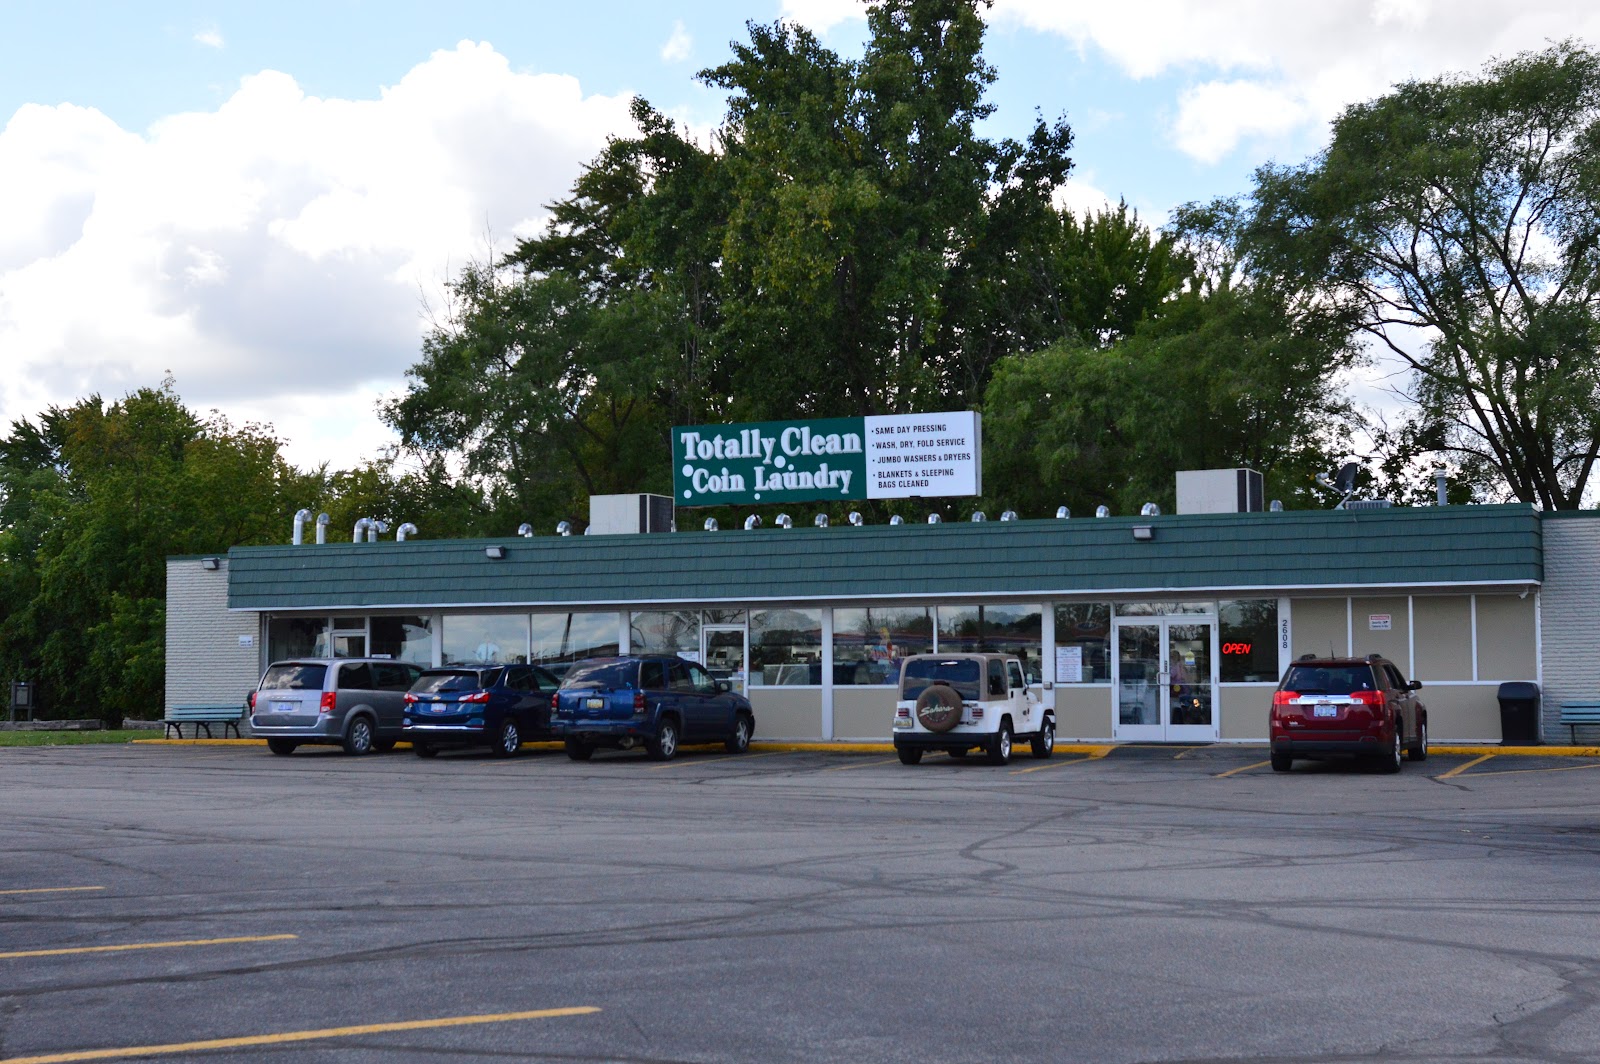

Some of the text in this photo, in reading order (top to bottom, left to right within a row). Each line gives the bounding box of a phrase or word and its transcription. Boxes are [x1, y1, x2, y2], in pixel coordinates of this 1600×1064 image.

[875, 424, 947, 435] SAME DAY PRESSING
[680, 426, 862, 464] Totally Clean
[876, 441, 898, 450] WASH,
[917, 439, 934, 448] FOLD
[936, 438, 965, 447] SERVICE
[877, 455, 902, 464] JUMBO
[903, 454, 937, 463] WASHERS
[943, 453, 971, 461] DRYERS
[692, 463, 853, 494] Coin Laundry
[878, 470, 913, 479] BLANKETS
[921, 468, 954, 477] SLEEPING
[878, 479, 929, 489] BAGS CLEANED
[1222, 642, 1251, 655] OPEN
[919, 704, 954, 717] Sahara
